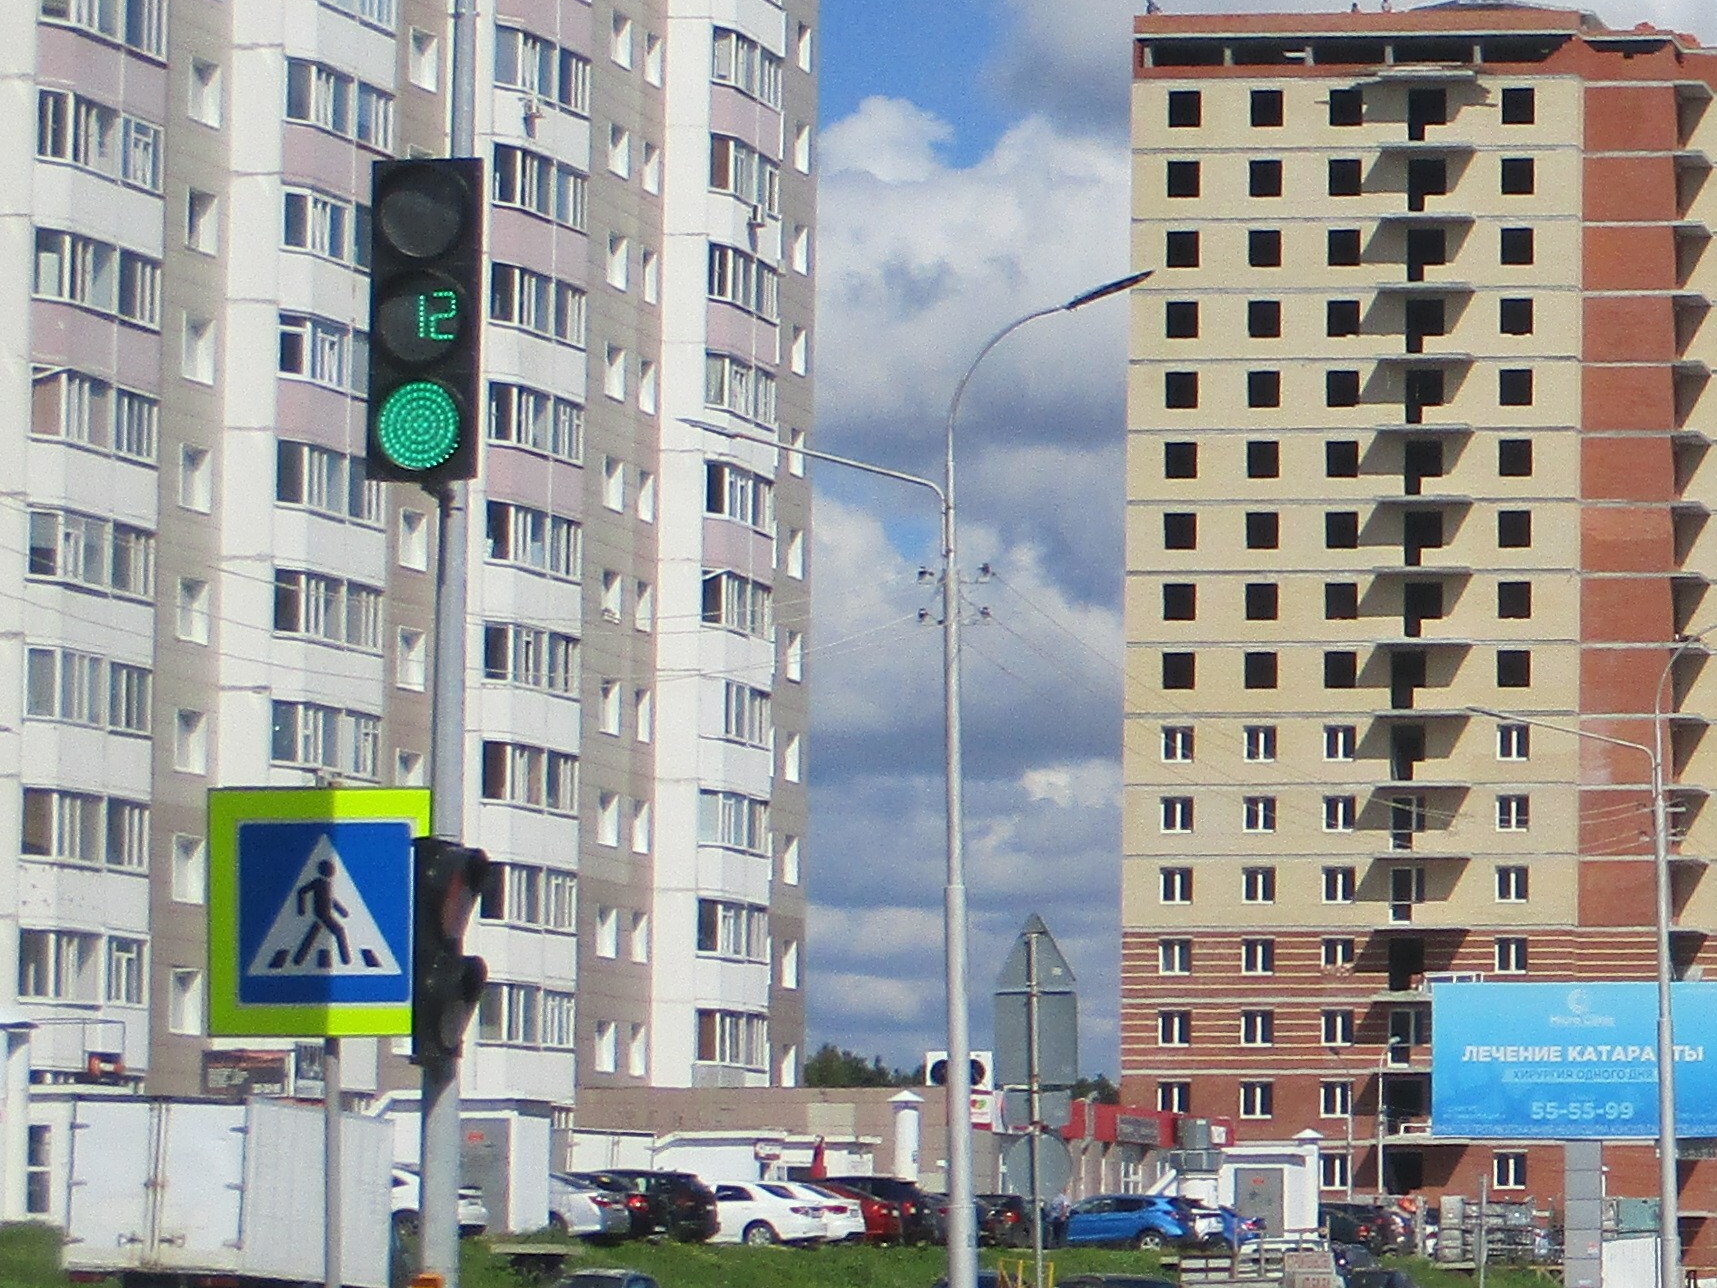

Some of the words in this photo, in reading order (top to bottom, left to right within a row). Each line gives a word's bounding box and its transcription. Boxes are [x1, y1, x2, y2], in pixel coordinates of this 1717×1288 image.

[418, 290, 458, 341] 12
[1461, 1045, 1562, 1062] ЛЕЧЕНИЕ
[1567, 1044, 1705, 1062] КАТАРАТЫ
[1513, 1069, 1573, 1081] ХИРУРГИЯ
[1576, 1069, 1626, 1081] ОДНОГО
[1530, 1101, 1634, 1120] 55-55-99
